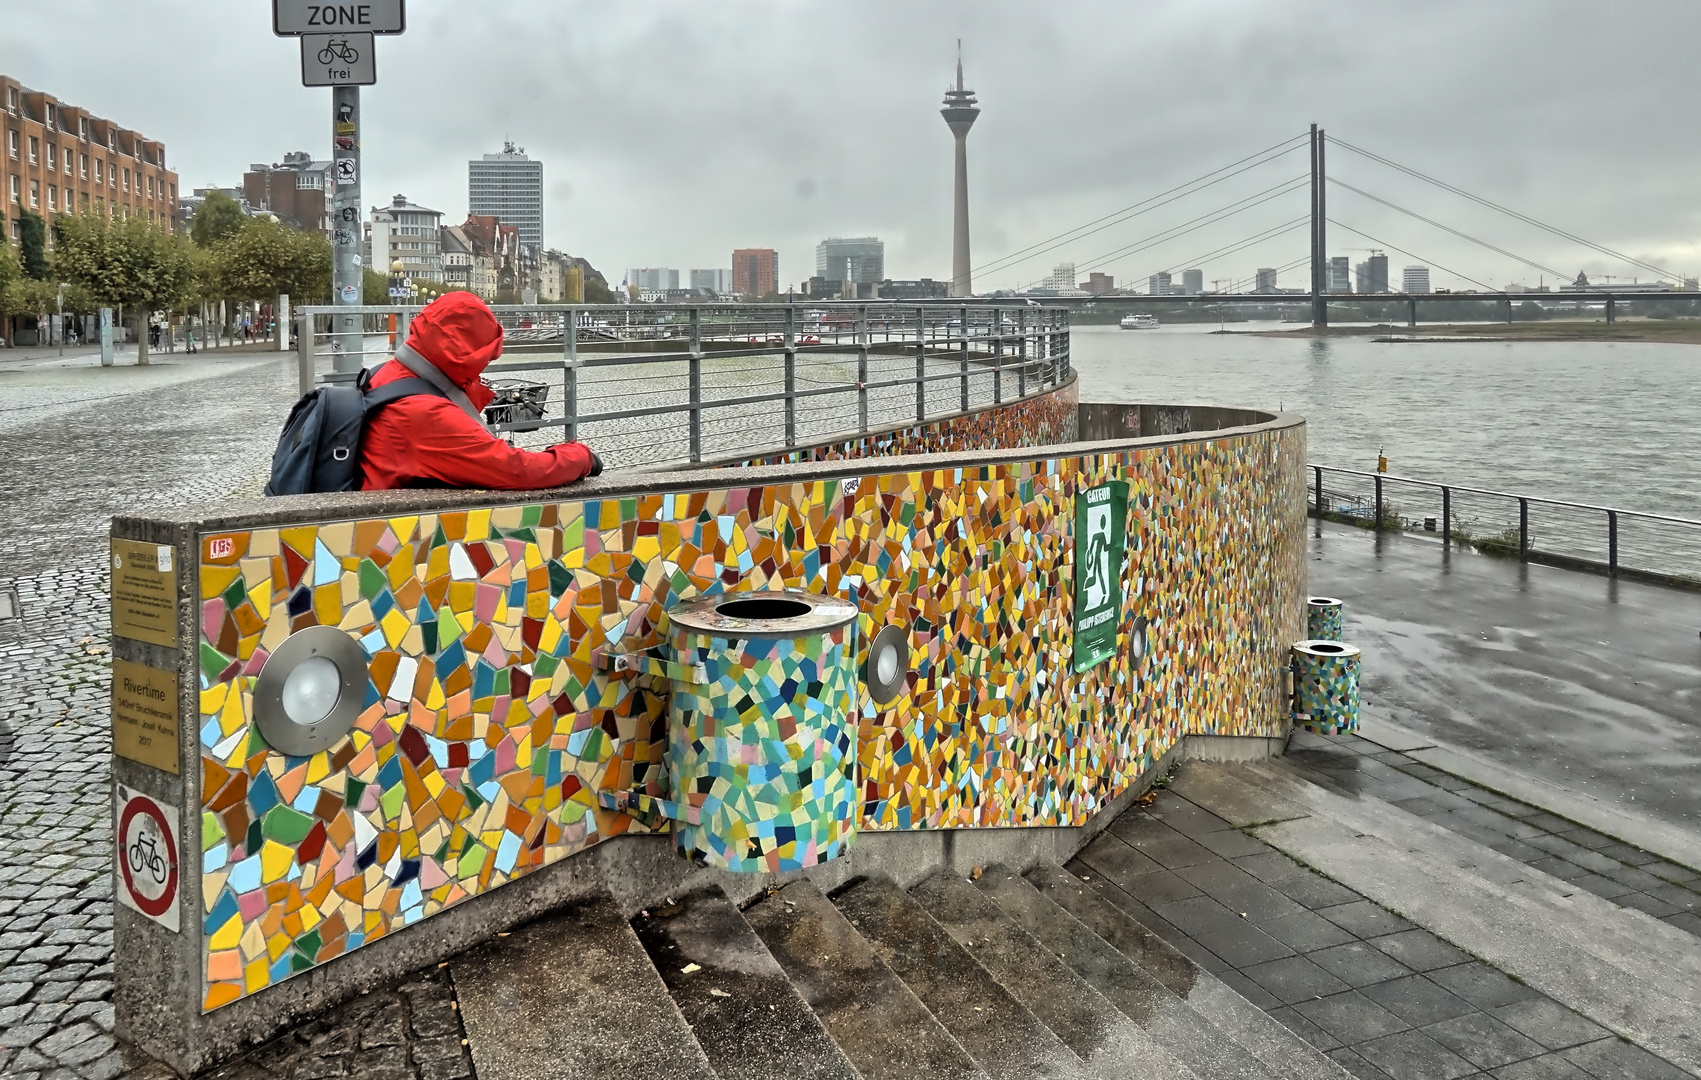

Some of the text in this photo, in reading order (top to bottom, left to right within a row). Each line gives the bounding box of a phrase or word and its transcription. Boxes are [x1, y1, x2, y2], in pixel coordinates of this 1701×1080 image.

[307, 5, 371, 25] ZONE
[328, 67, 351, 79] frei
[123, 677, 166, 701] Rivertime
[136, 702, 173, 721] Bruchkeramik
[138, 735, 152, 747] 2017
